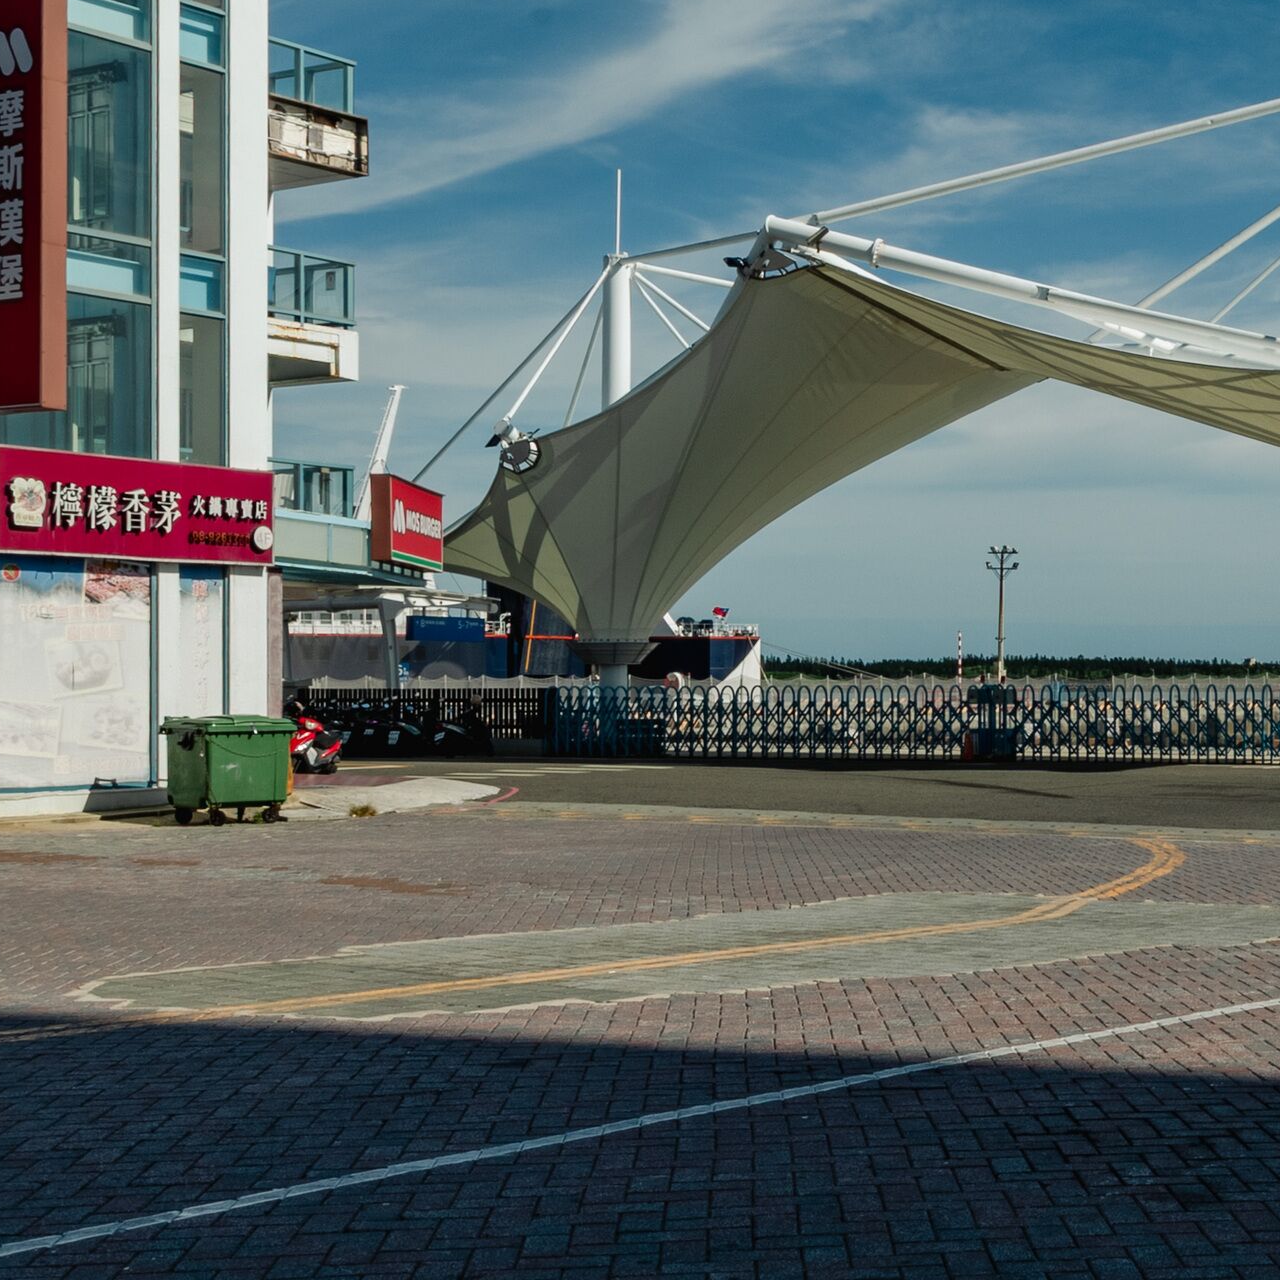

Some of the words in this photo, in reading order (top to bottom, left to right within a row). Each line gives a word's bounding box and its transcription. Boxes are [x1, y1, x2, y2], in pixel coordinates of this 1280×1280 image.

[51, 481, 183, 534] 檸檬香茅
[192, 494, 268, 520] 火鍋專賣店
[406, 509, 420, 533] MOS
[420, 514, 441, 539] BURGER
